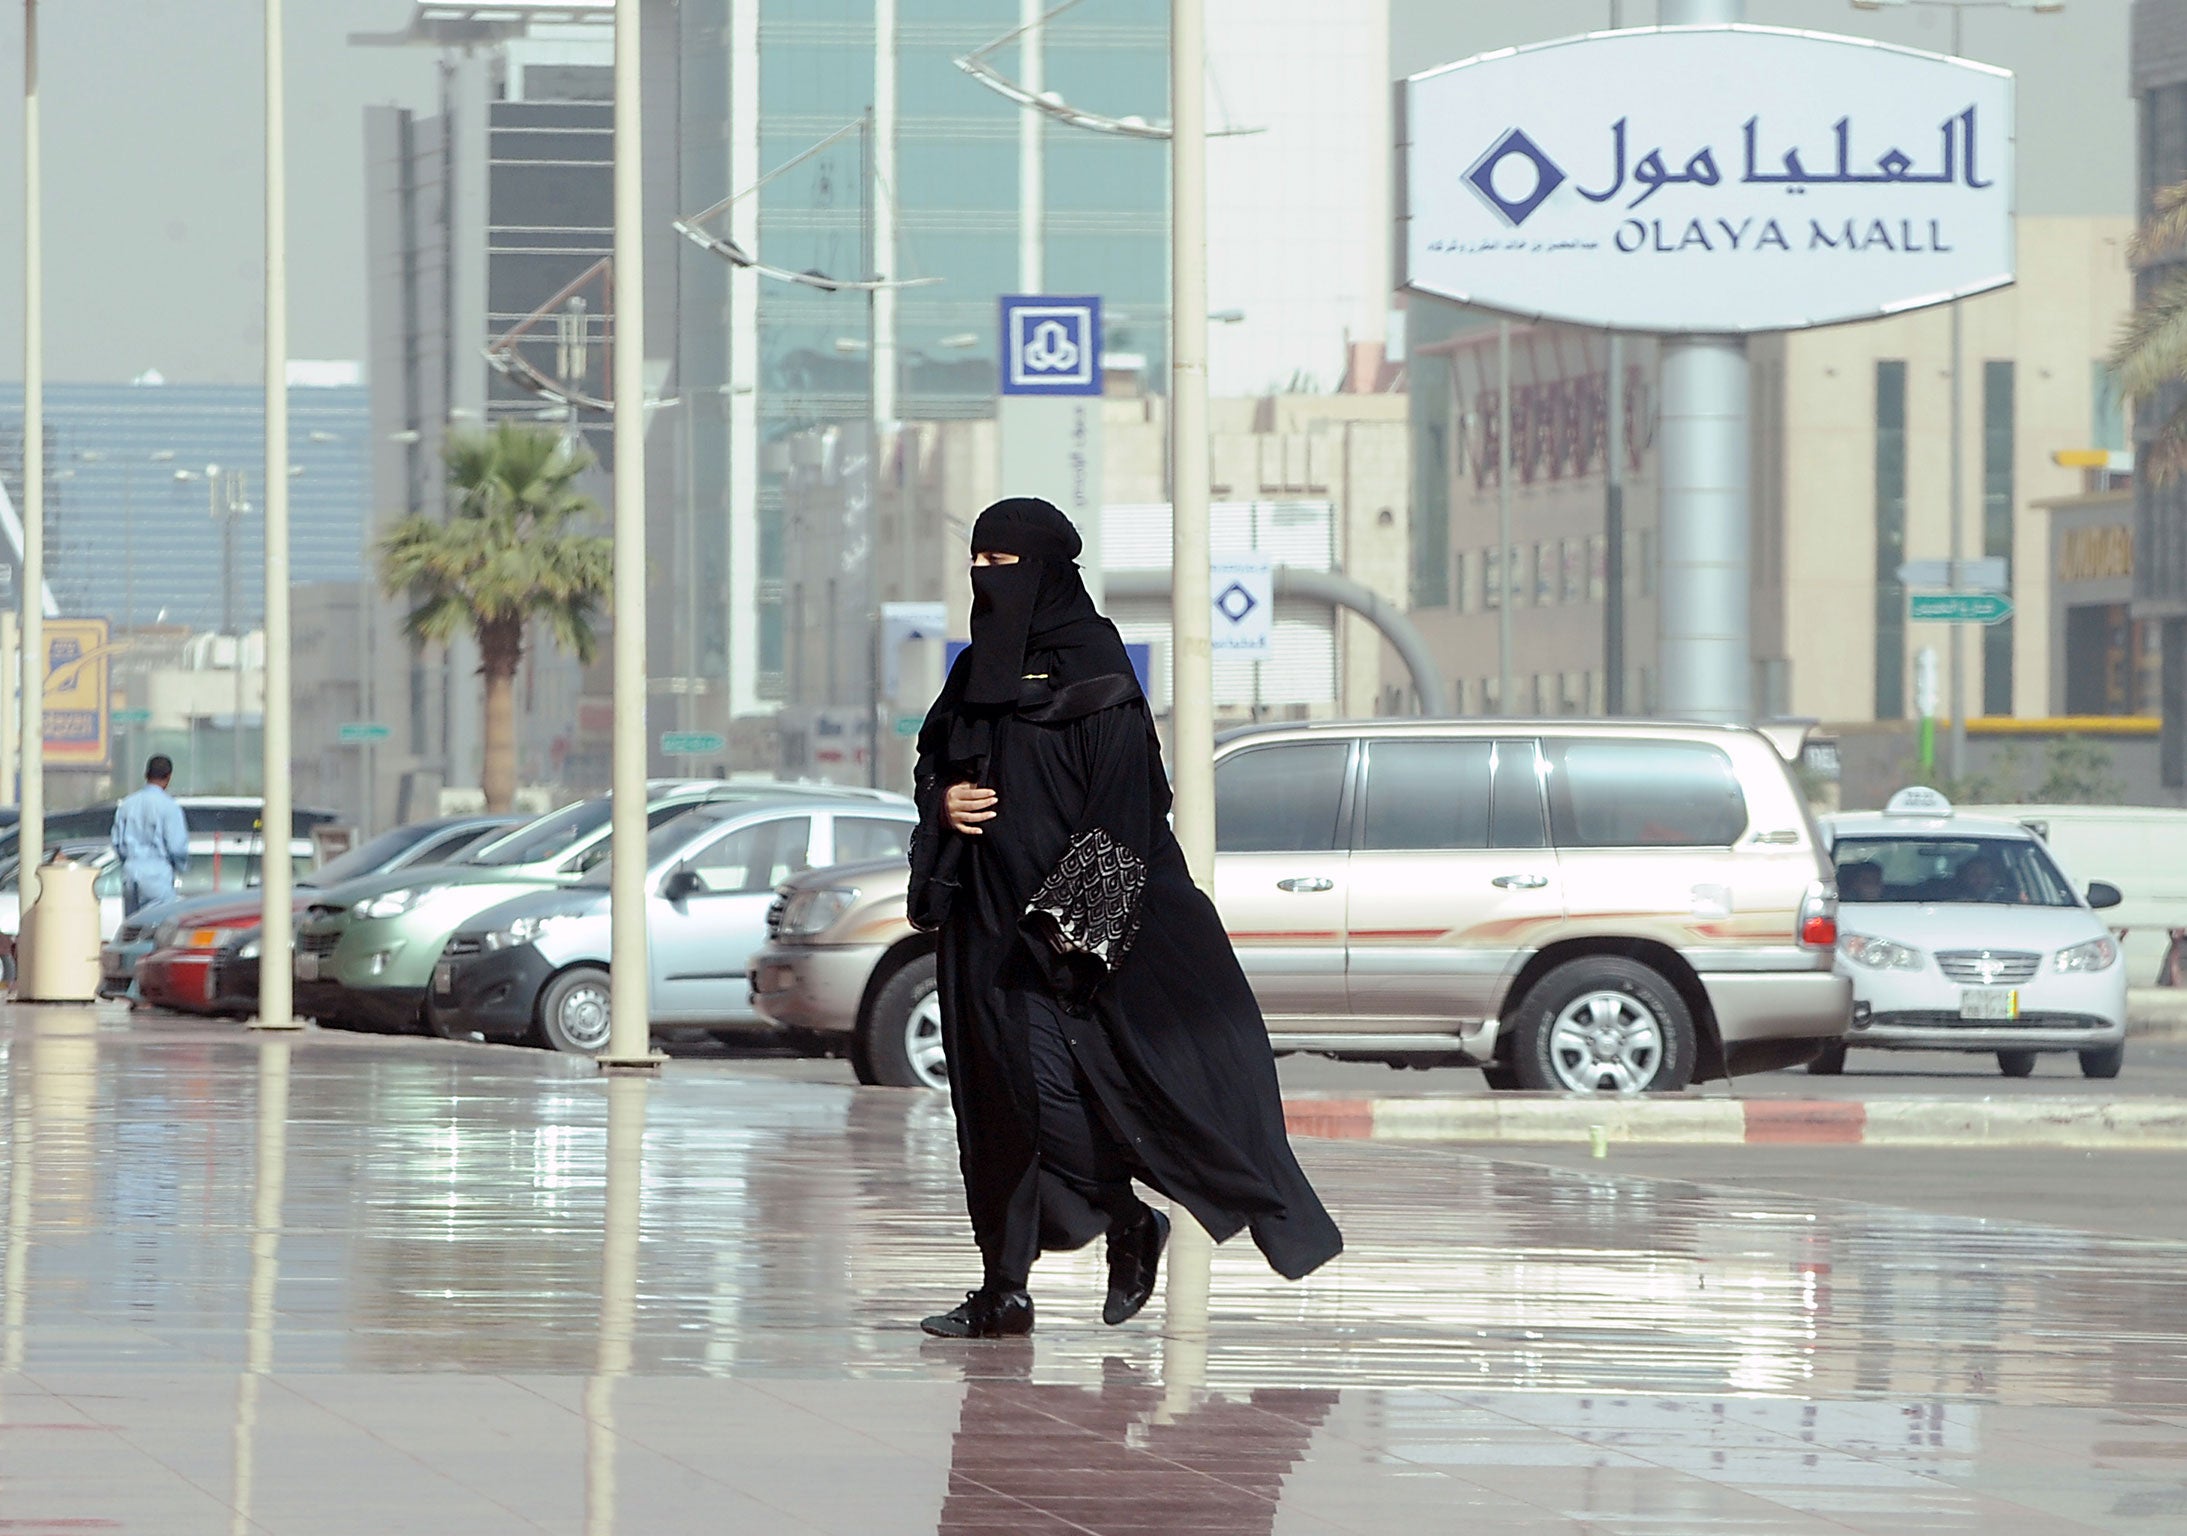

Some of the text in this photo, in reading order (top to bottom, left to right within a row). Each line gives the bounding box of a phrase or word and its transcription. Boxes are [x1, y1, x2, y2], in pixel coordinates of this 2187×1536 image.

[1576, 104, 1994, 210] العليا مول
[1613, 218, 1953, 253] OLAYA MALL
